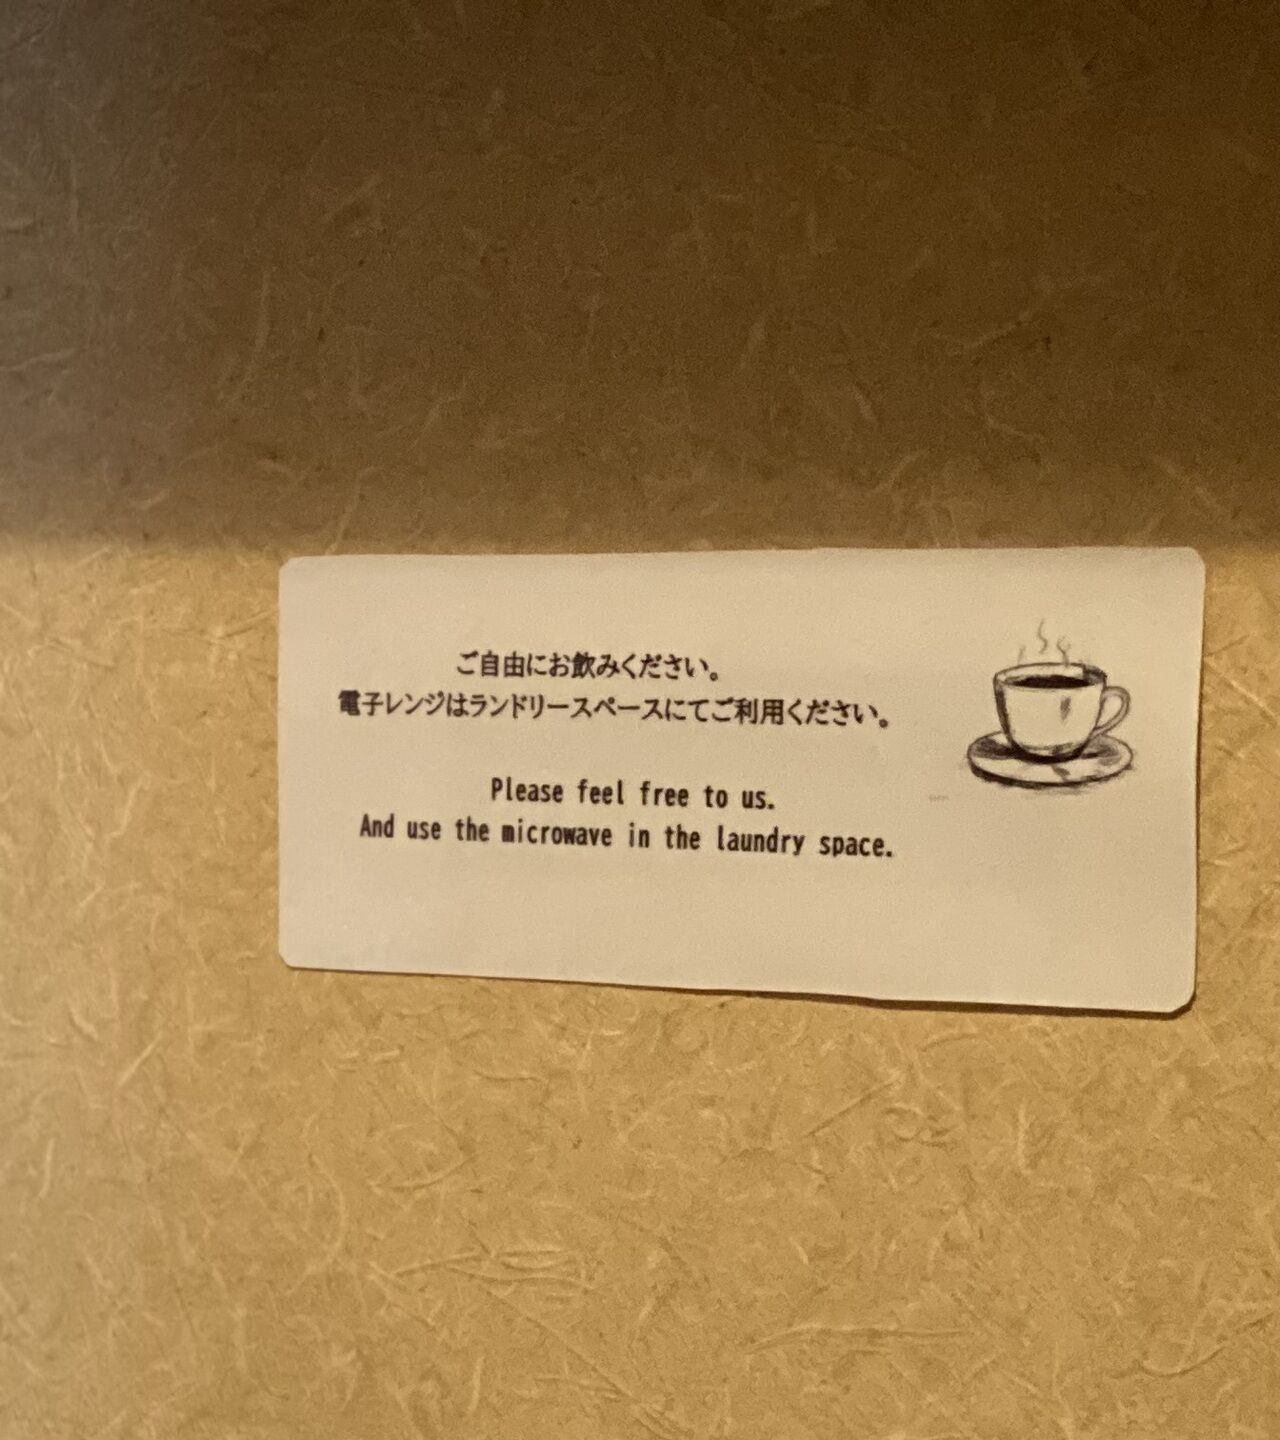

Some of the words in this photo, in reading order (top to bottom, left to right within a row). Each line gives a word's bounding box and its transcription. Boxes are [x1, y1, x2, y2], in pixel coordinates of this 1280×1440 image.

[456, 650, 718, 682] ご自由にお飲みください。
[338, 690, 888, 729] 電子レンジはランドリースペースにてご利用ください。
[490, 776, 564, 804] Please
[577, 778, 625, 805] feel
[640, 781, 690, 807] free
[703, 785, 729, 809] to
[741, 788, 775, 811] us.
[359, 813, 395, 839] And
[406, 820, 441, 841] use
[455, 816, 490, 842] the
[501, 818, 613, 847] microwave
[628, 822, 651, 849] in
[665, 824, 701, 851] the
[717, 825, 806, 857] laundry
[819, 834, 894, 858] space.
